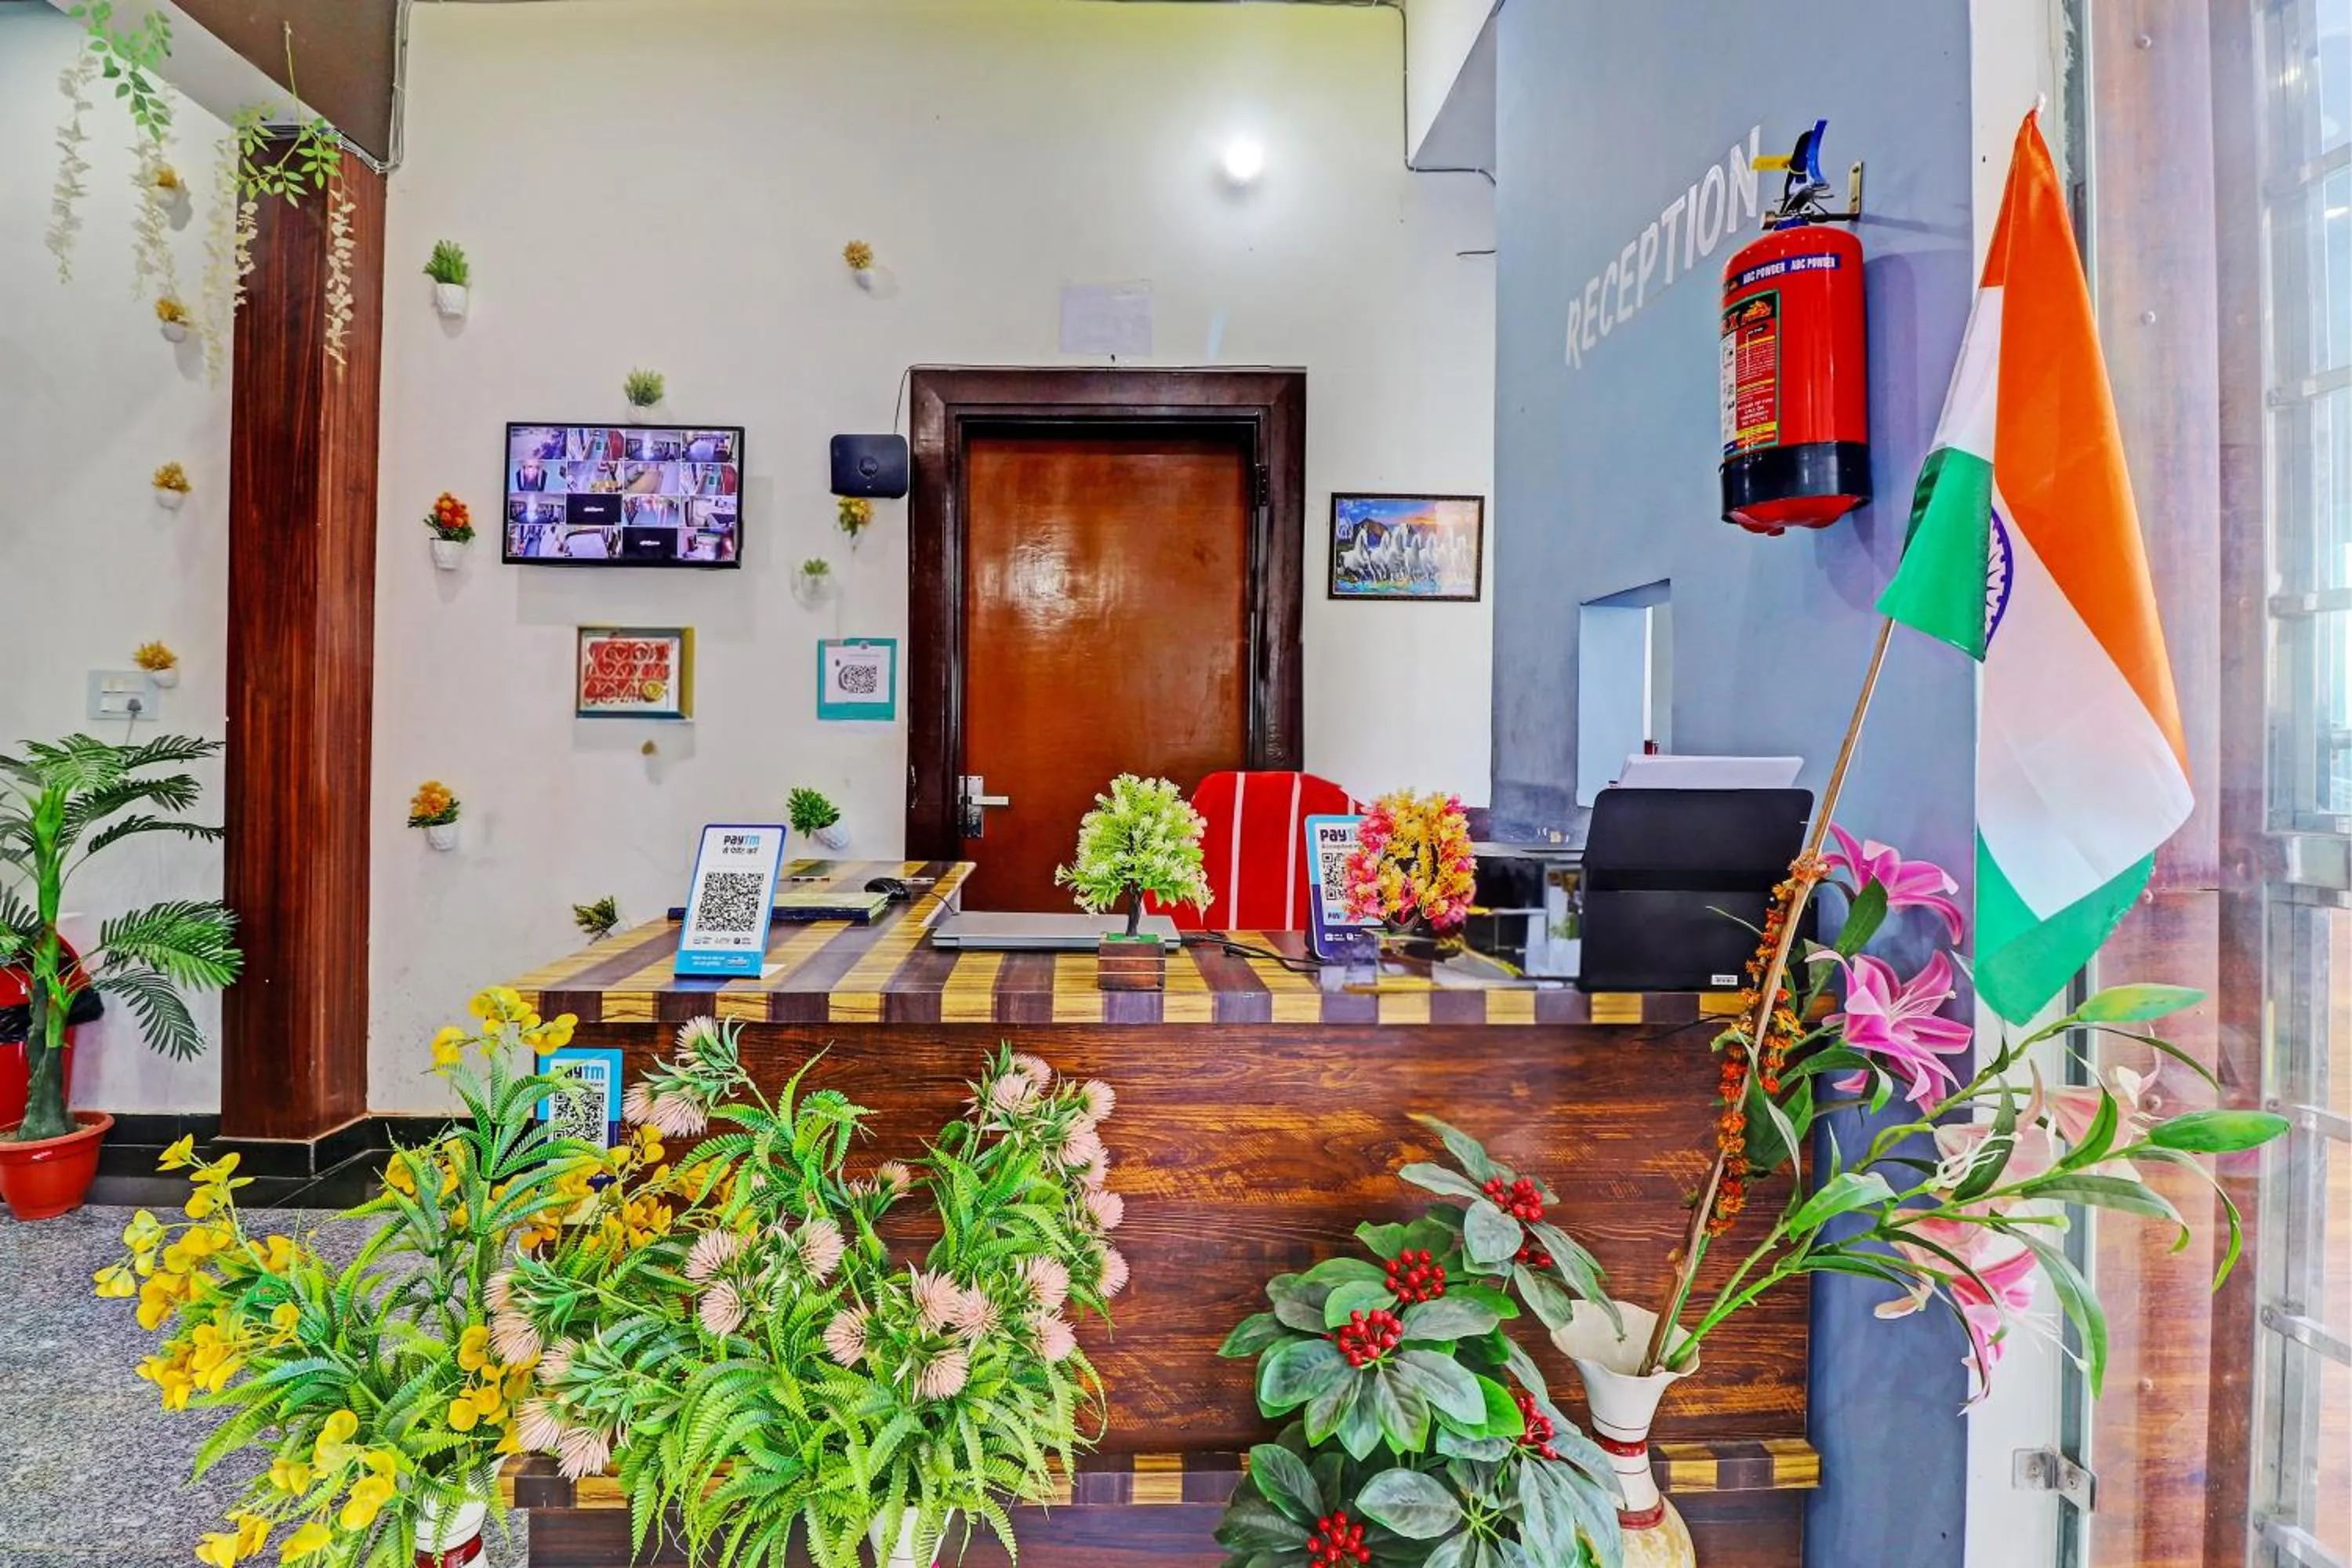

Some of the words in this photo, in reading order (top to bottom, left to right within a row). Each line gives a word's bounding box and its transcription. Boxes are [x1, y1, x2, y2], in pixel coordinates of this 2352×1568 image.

[1565, 125, 1761, 371] RECEPTION
[1755, 261, 1786, 281] POWDER
[1807, 256, 1836, 269] POWDER
